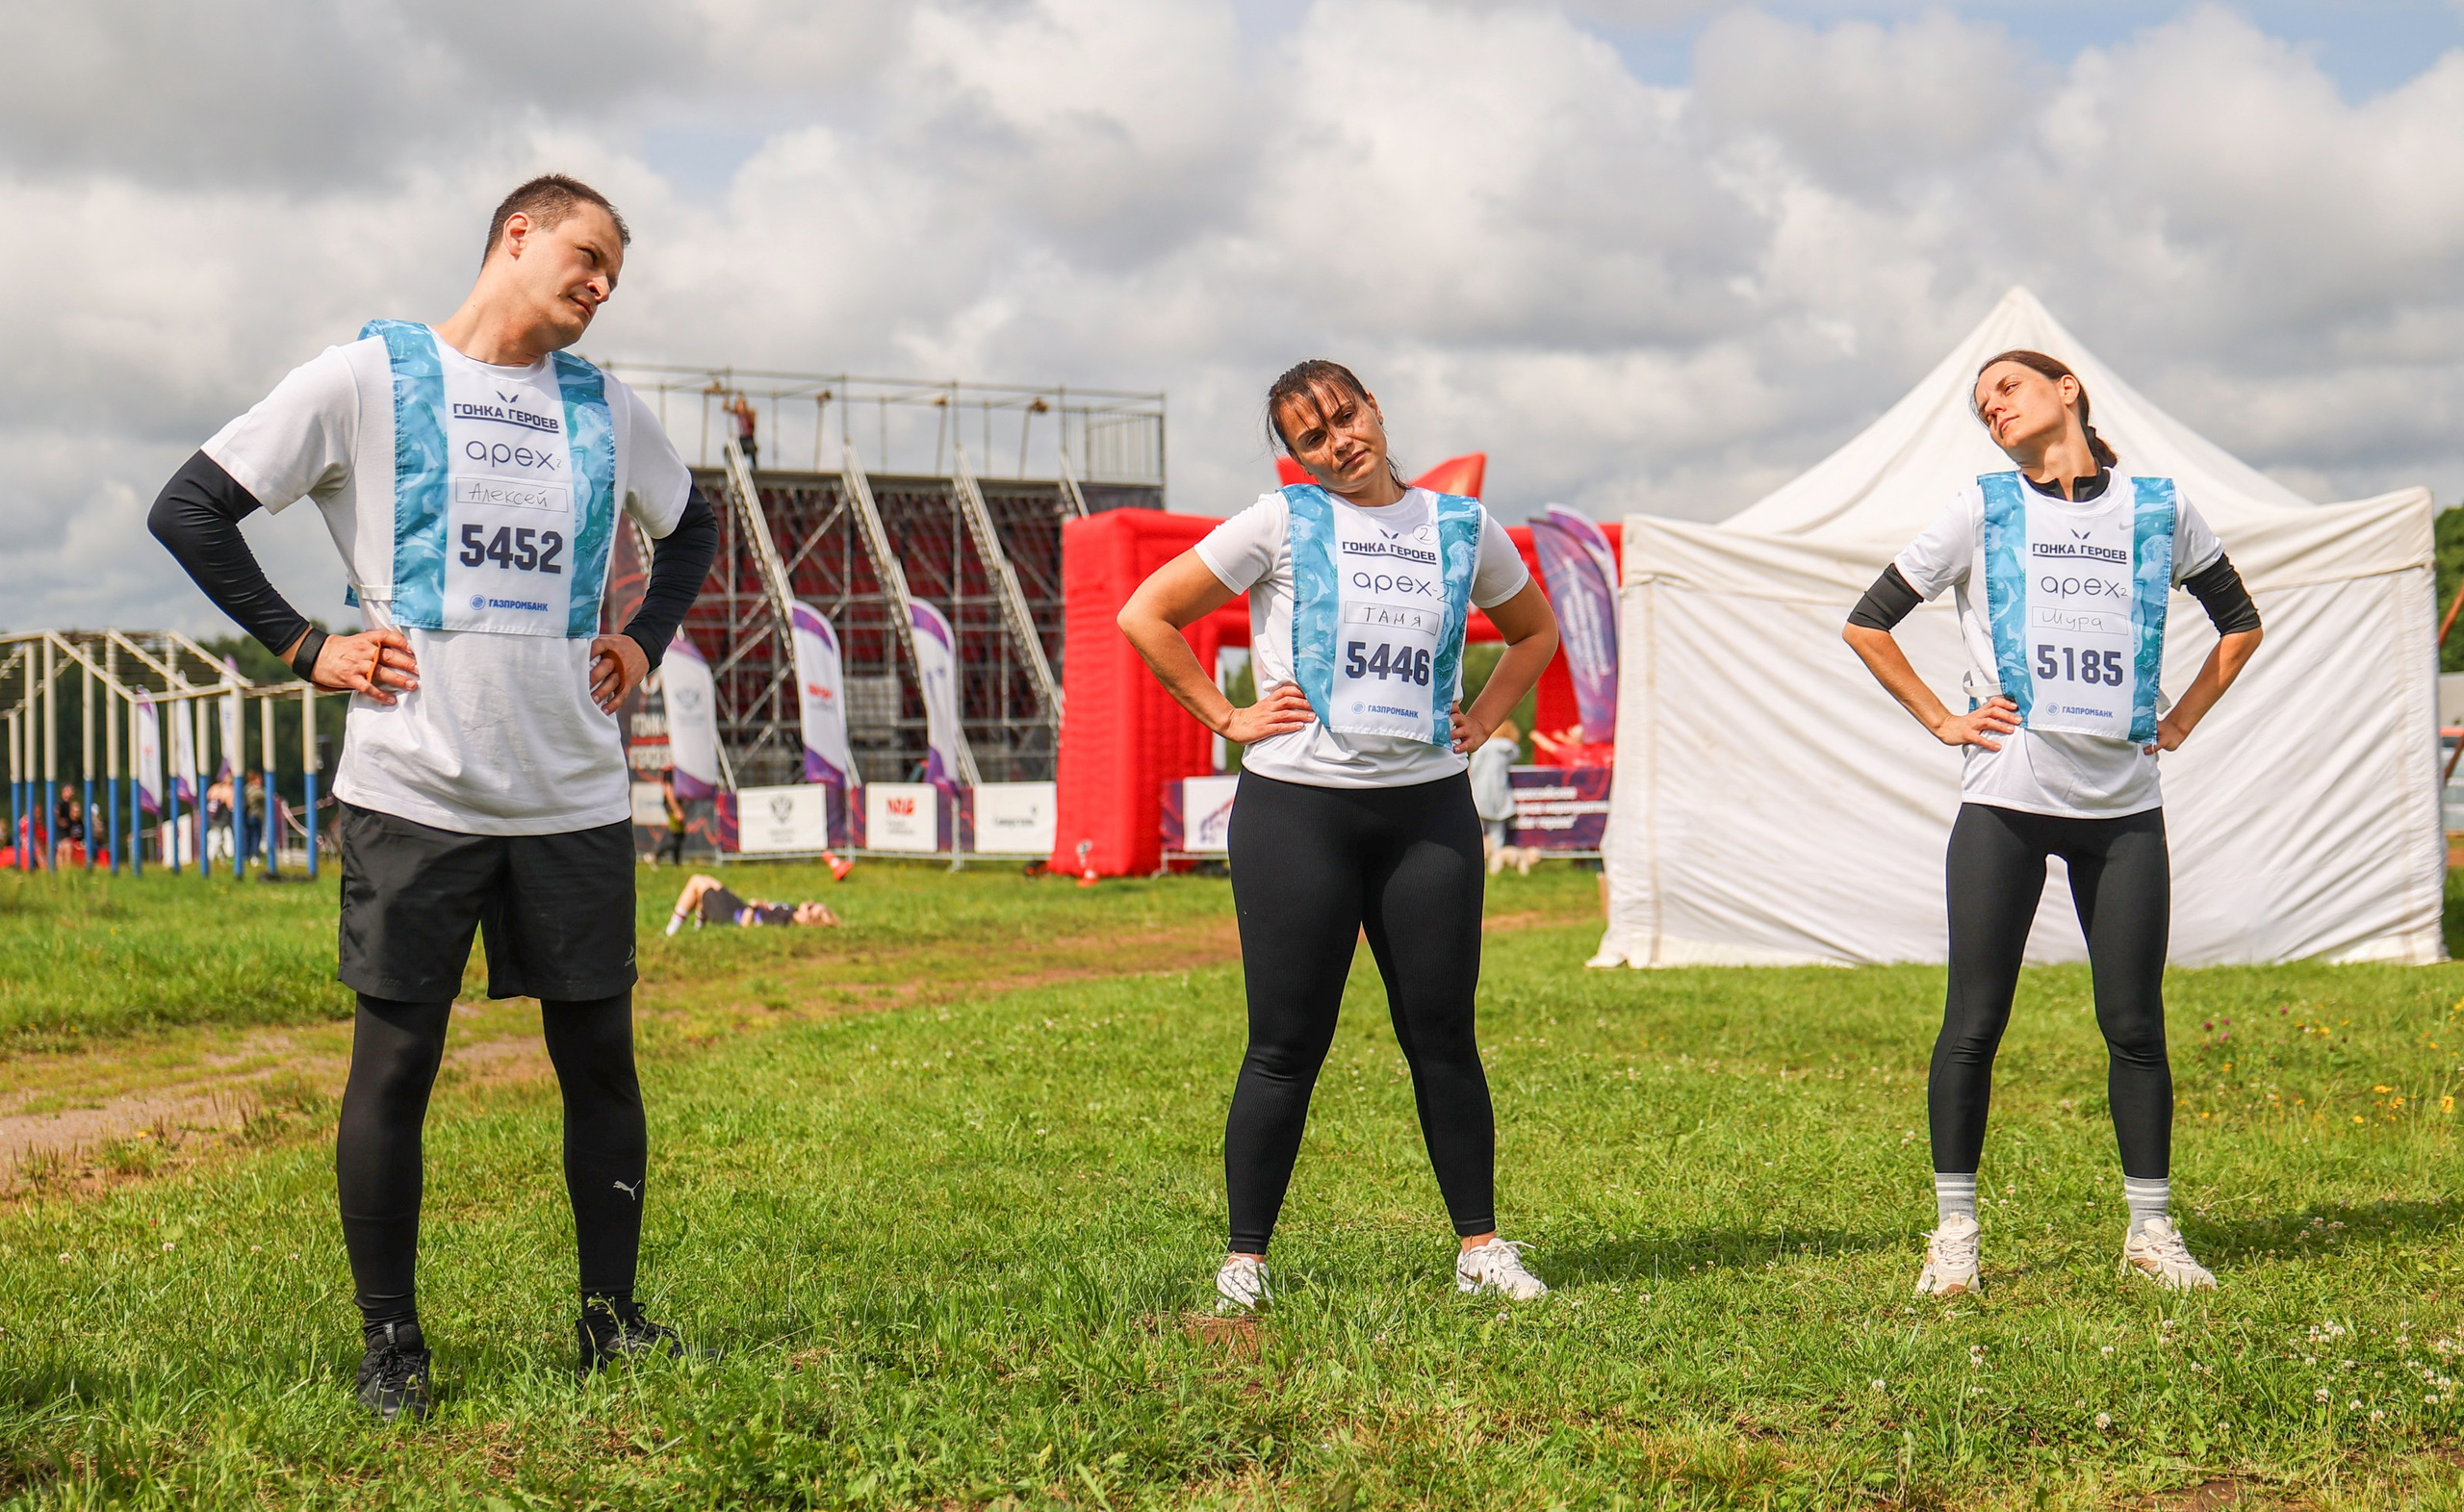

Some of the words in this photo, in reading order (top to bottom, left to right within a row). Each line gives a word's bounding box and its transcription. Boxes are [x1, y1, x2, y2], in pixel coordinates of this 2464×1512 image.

[452, 403, 504, 420] ГОНКА
[508, 408, 559, 430] ГЕРОЕВ
[466, 440, 555, 472] apex
[468, 482, 548, 507] Алексей
[1420, 527, 1429, 541] 2
[459, 524, 563, 575] 5452
[1342, 541, 1386, 553] ГОНКА
[1390, 544, 1437, 561] ГЕРОЕВ
[2032, 543, 2075, 554] ГОНКА
[2080, 545, 2127, 561] ГЕРОЕВ
[1352, 572, 1432, 598] apex
[2040, 576, 2120, 600] apex
[488, 599, 549, 612] ГАЗПРОМБАНК
[2042, 608, 2104, 631] Шура
[1346, 641, 1430, 687] 5446
[2037, 644, 2124, 687] 5185
[1368, 705, 1419, 719] ГАЗПРОМБАНК
[2062, 705, 2114, 719] ГАЗПРОМБАНК
